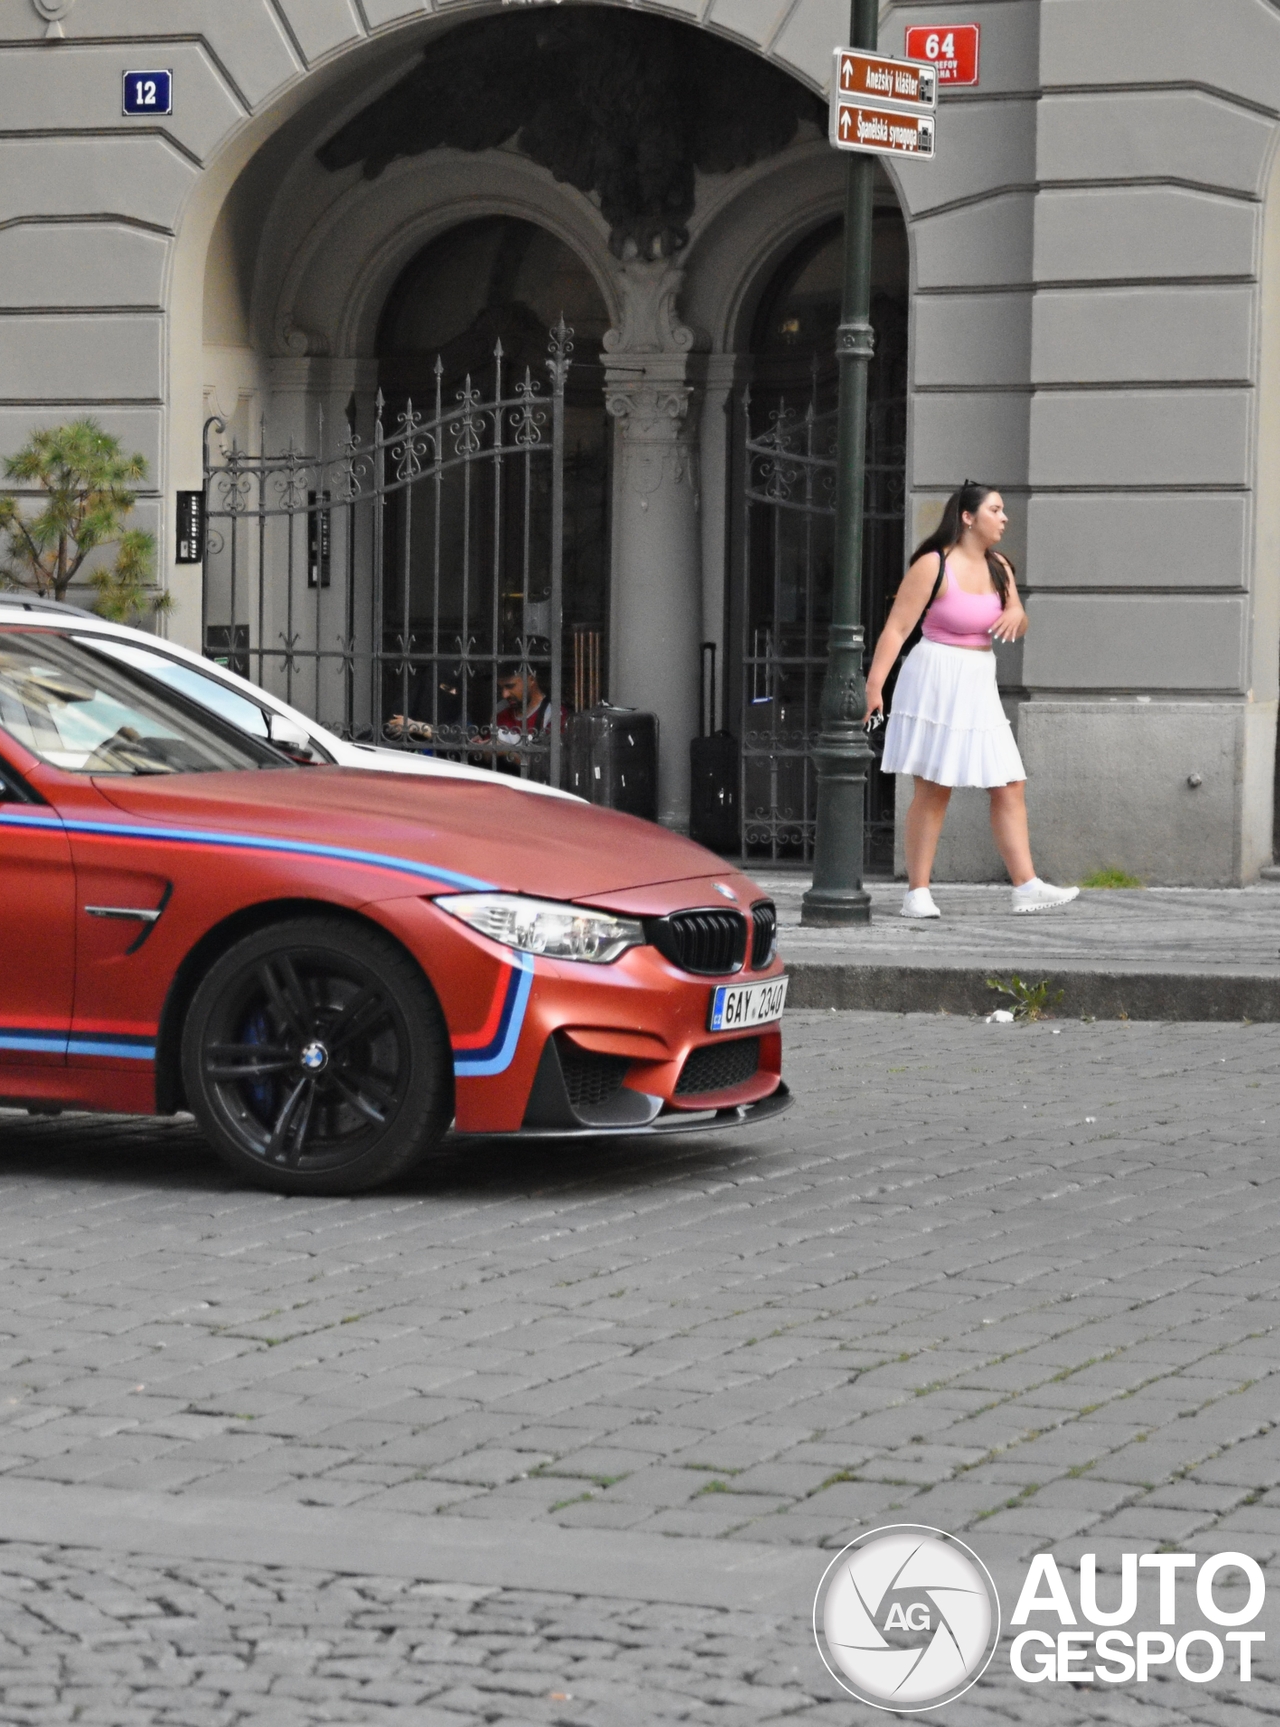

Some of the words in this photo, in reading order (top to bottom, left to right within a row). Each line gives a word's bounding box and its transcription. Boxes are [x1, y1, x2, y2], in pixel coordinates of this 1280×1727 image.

[926, 33, 955, 58] 64
[866, 65, 893, 97] Anežský
[895, 70, 918, 95] klášter
[952, 69, 957, 78] 1
[136, 81, 156, 104] 12
[857, 110, 888, 144] Španělská
[889, 125, 917, 151] synagoga
[726, 990, 752, 1023] 6AY
[758, 984, 784, 1018] 2340
